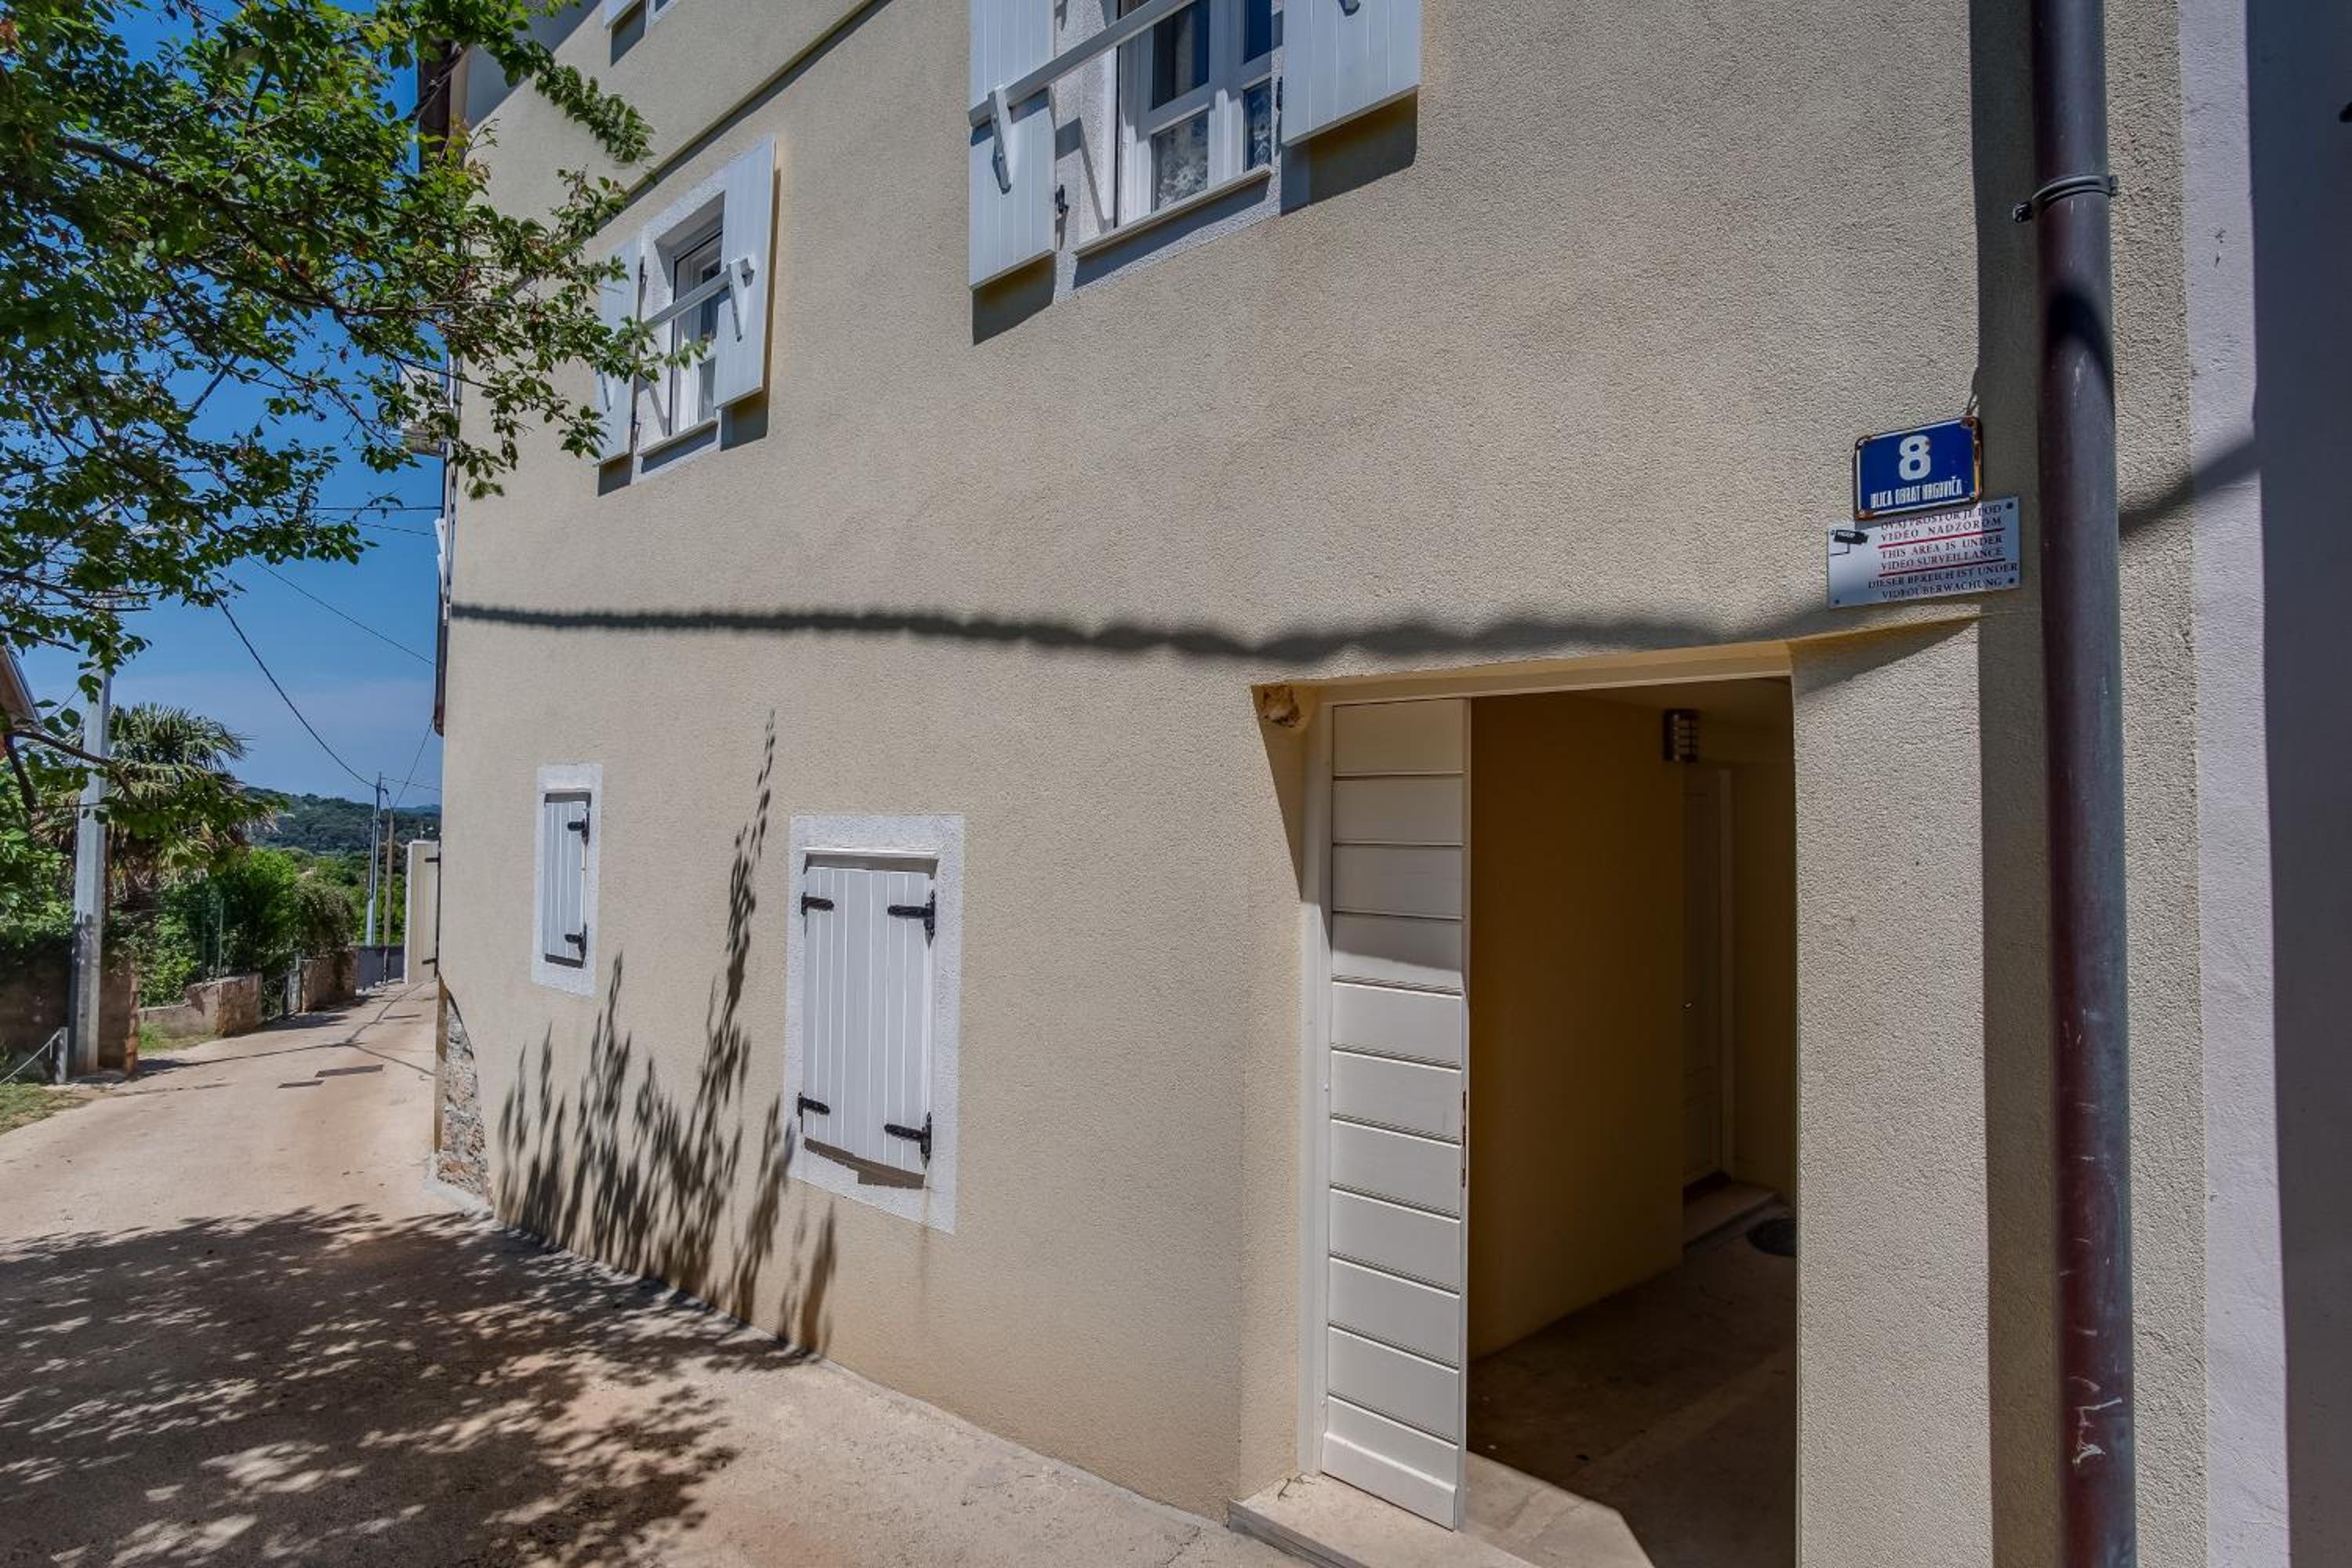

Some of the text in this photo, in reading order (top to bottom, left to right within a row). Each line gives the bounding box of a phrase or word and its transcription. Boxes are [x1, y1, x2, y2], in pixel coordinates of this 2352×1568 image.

[1899, 435, 1931, 481] 8
[1870, 491, 1893, 508] ULICA
[1882, 517, 2002, 541] VIDEO NADZOROM
[1882, 535, 2003, 558] THIS AREA IS UNDER
[1882, 547, 2002, 571] VIDEO SURVEILLANCE
[1868, 563, 2017, 589] DIESER BEREICH IST UNDER
